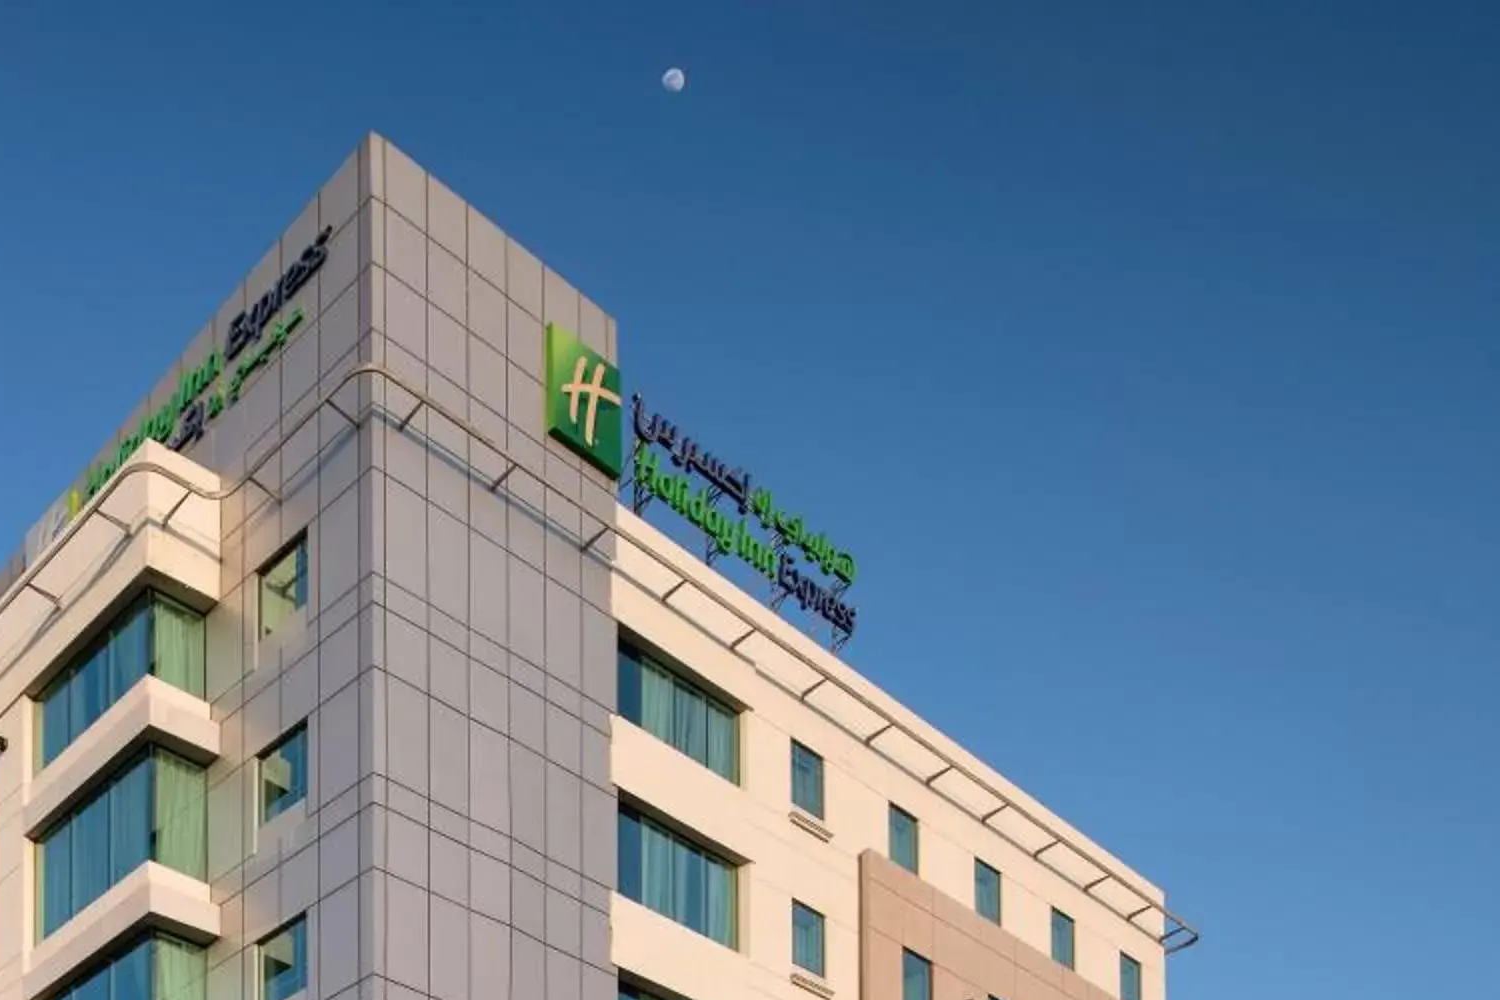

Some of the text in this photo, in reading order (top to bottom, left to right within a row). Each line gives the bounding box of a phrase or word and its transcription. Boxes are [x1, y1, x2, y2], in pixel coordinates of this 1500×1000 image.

[224, 224, 333, 364] Express
[636, 440, 856, 638] Holiday Inn Express
